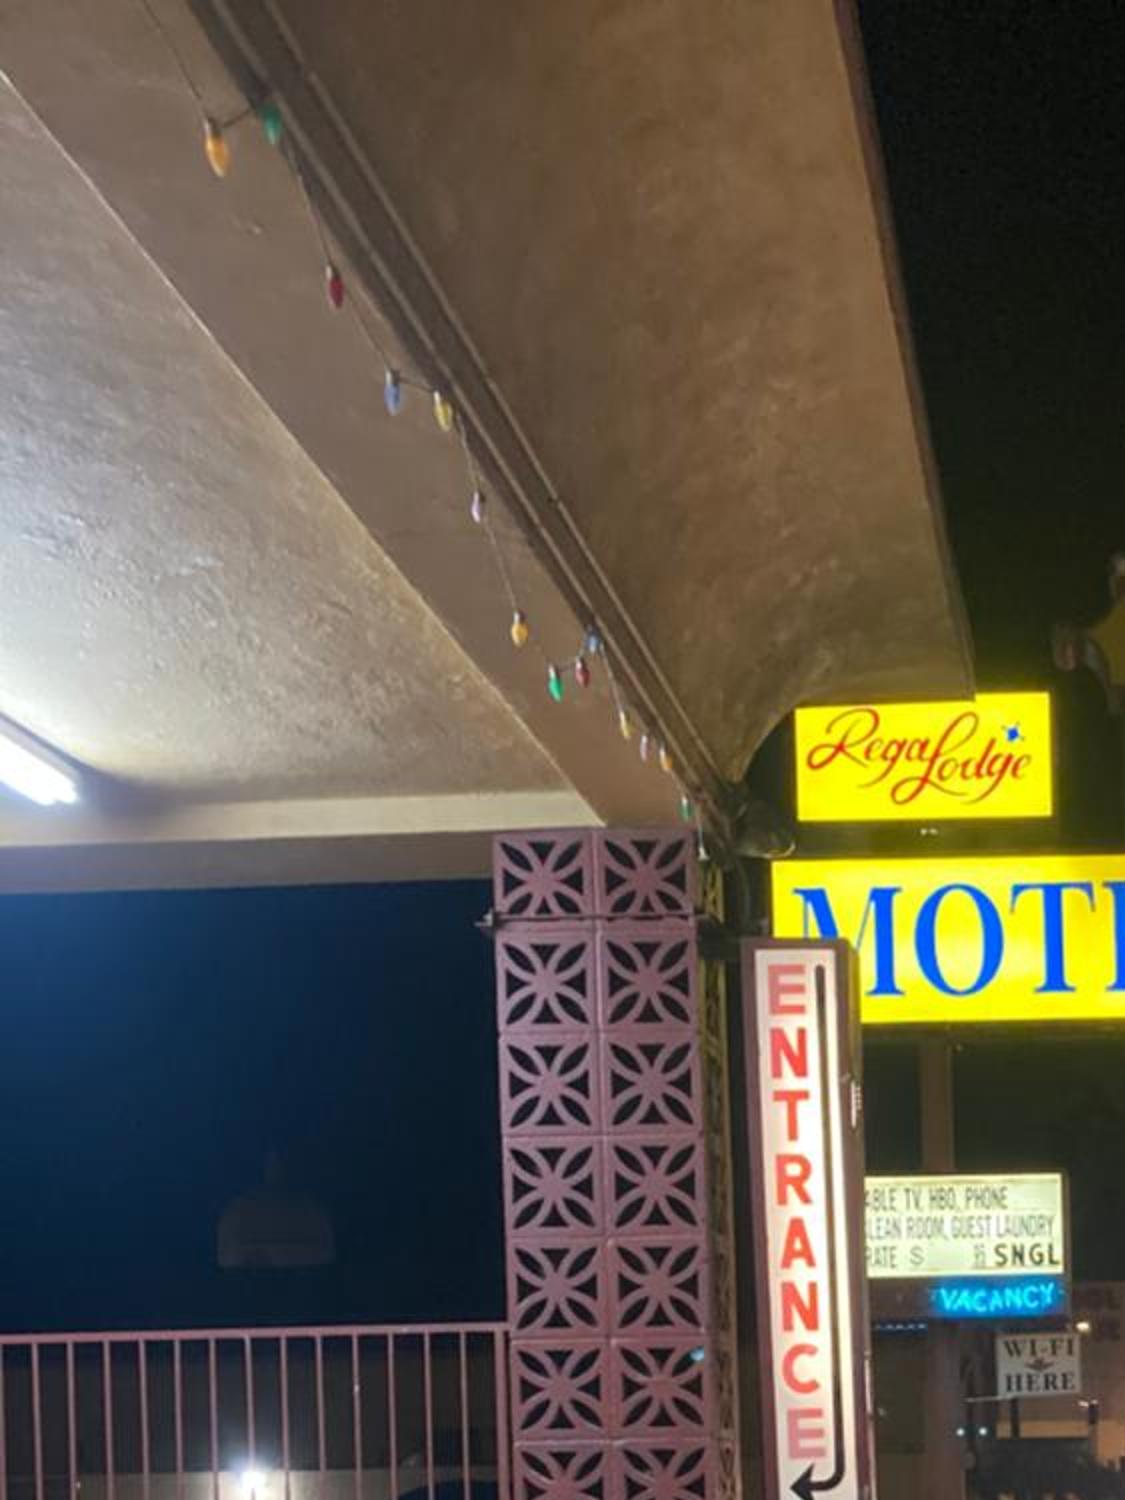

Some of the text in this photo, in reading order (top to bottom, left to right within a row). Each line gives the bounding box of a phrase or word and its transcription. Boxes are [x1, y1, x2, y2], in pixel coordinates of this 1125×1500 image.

[965, 1185, 1008, 1211] PHONE
[767, 963, 828, 1461] ENTRANCE
[867, 1215, 901, 1239] LEAN
[951, 1214, 992, 1239] GUEST
[996, 1213, 1055, 1239] LAUNDRY
[994, 1242, 1061, 1267] SNGL
[939, 1282, 1055, 1313] VACANCY
[1003, 1337, 1074, 1358] WI-FI
[1005, 1371, 1075, 1393] HERE
